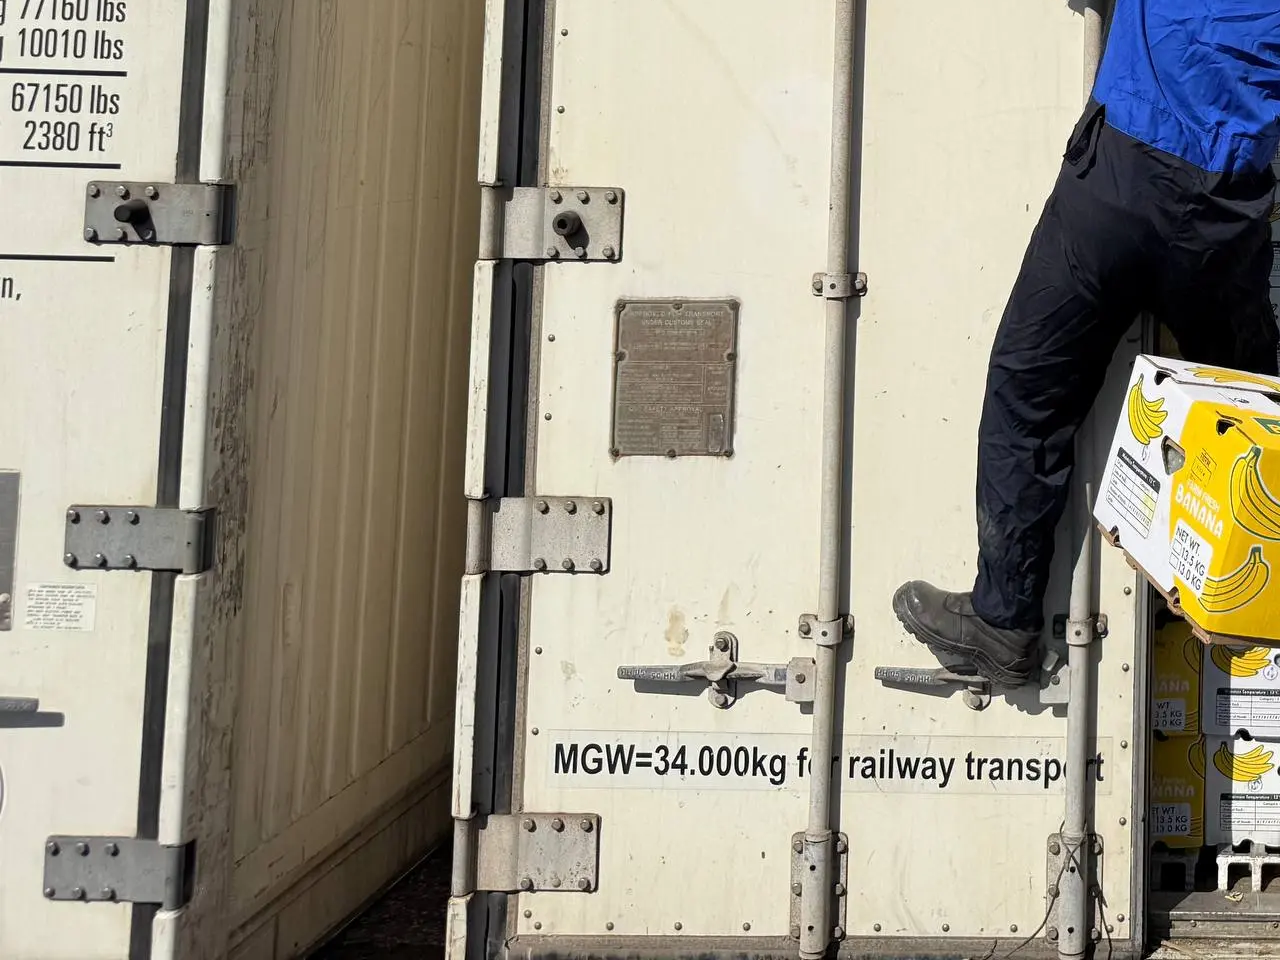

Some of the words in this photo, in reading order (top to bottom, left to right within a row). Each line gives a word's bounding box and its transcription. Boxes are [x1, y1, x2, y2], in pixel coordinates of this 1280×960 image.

[18, 28, 87, 59] 10010
[93, 30, 124, 60] lbs
[11, 83, 83, 114] 67150
[89, 85, 120, 115] lbs
[22, 120, 81, 151] 2380
[1175, 483, 1224, 539] BANANA
[1176, 527, 1189, 544] NET
[1189, 536, 1200, 557] WT.
[1177, 561, 1191, 580] 13.0
[1191, 574, 1202, 591] KG
[1181, 547, 1195, 567] 13.5
[1195, 560, 1206, 577] KG
[553, 743, 787, 785] MGW=34.000kg
[797, 748, 840, 780] fr
[848, 751, 956, 789] railway
